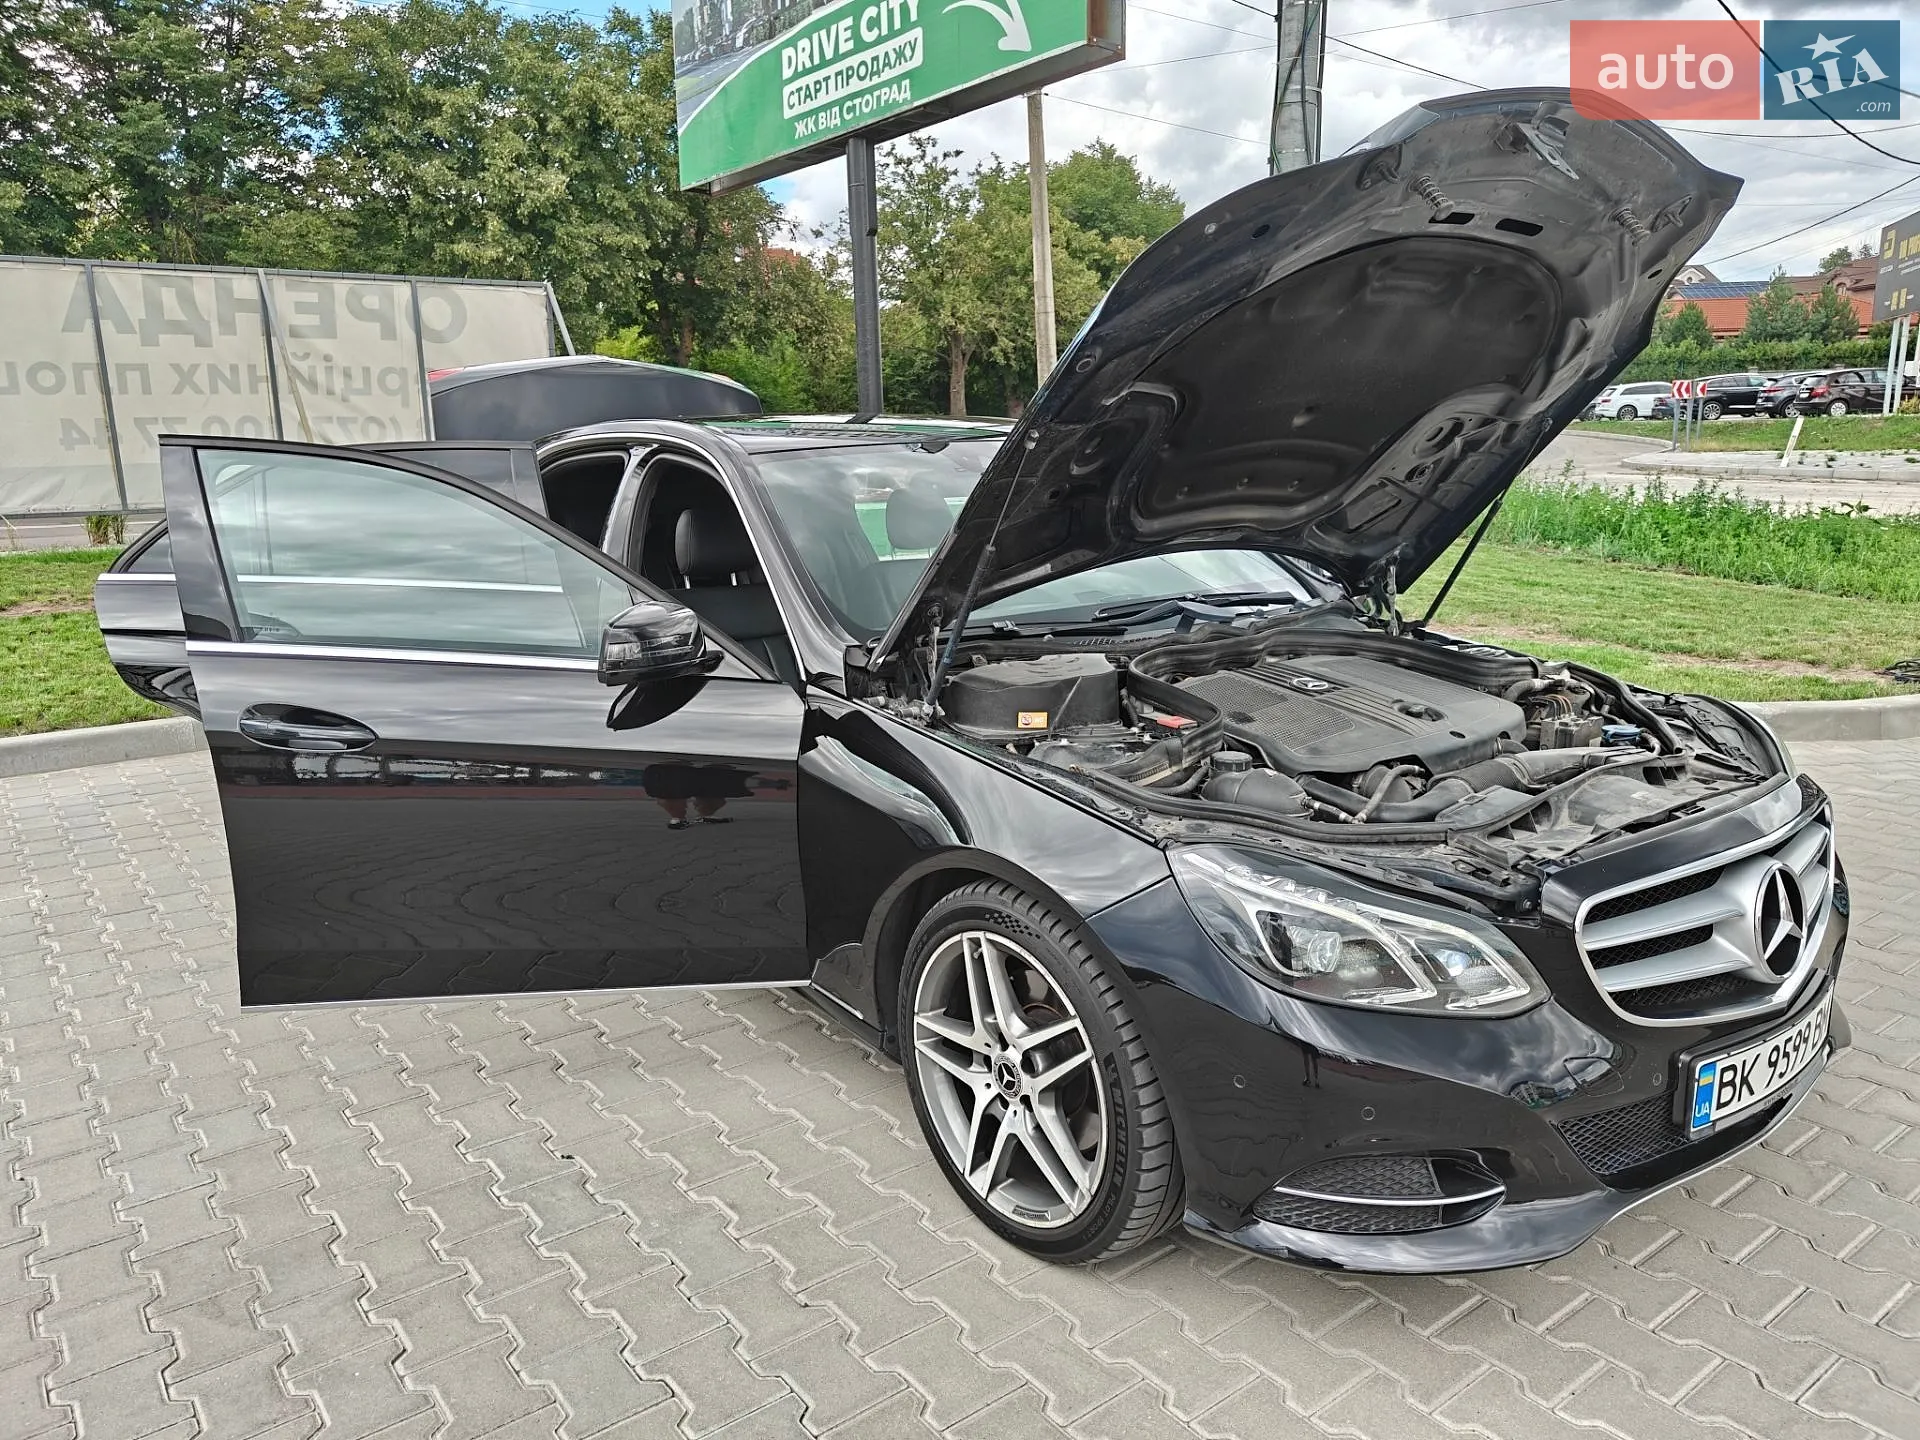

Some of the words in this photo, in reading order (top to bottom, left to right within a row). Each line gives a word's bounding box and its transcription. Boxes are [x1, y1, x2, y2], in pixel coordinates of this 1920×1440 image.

[782, 16, 854, 80] DRIVE
[860, 0, 919, 43] CITY
[787, 75, 831, 111] СТАРТ
[834, 37, 918, 92] ПРОДАЖУ
[794, 115, 816, 139] ЖК
[818, 106, 840, 130] ВІД
[843, 79, 911, 120] СТОГРАД
[1716, 1053, 1761, 1111] BK
[1765, 1021, 1811, 1089] 9599
[1111, 1087, 1127, 1187] MICHELIN
[1695, 1101, 1710, 1118] UA
